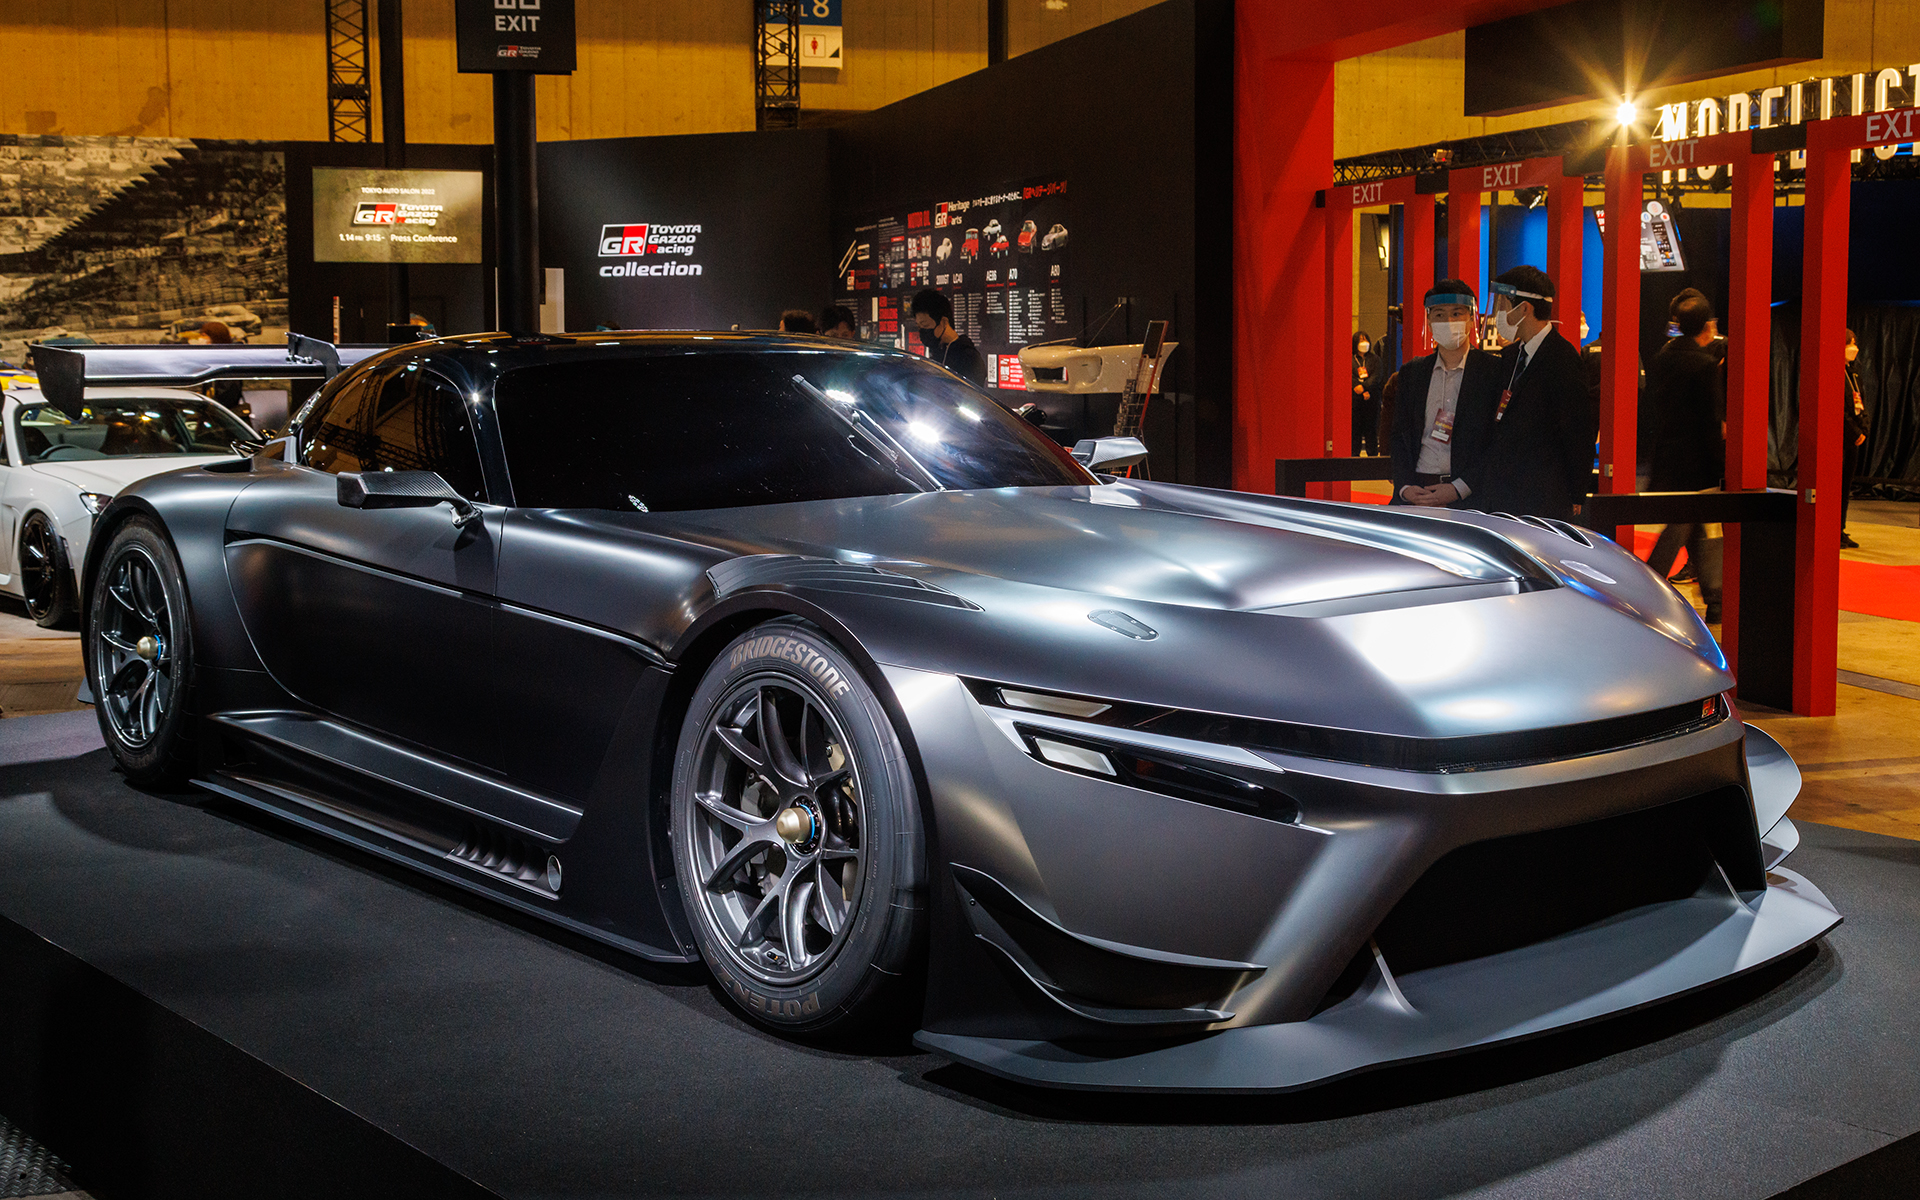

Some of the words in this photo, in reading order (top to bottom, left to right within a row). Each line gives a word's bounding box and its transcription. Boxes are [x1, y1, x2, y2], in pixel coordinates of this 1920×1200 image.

[812, 0, 830, 18] 8
[494, 15, 540, 32] EXIT
[1650, 139, 1699, 168] EXIT
[1483, 163, 1522, 188] EXIT
[1352, 182, 1384, 205] EXIT
[400, 203, 443, 212] TOYOTA
[948, 200, 970, 213] Heritage
[356, 210, 395, 223] GR
[397, 210, 439, 218] GAZOO
[935, 213, 947, 226] GR
[395, 217, 437, 226] Racing
[650, 224, 702, 234] TOYOTA
[390, 234, 411, 242] Press
[412, 234, 458, 243] Conference
[601, 236, 644, 254] GR
[648, 234, 697, 245] GAZOO
[646, 244, 694, 256] Racing
[599, 260, 703, 277] collection
[730, 636, 850, 700] BRIDGESTONE
